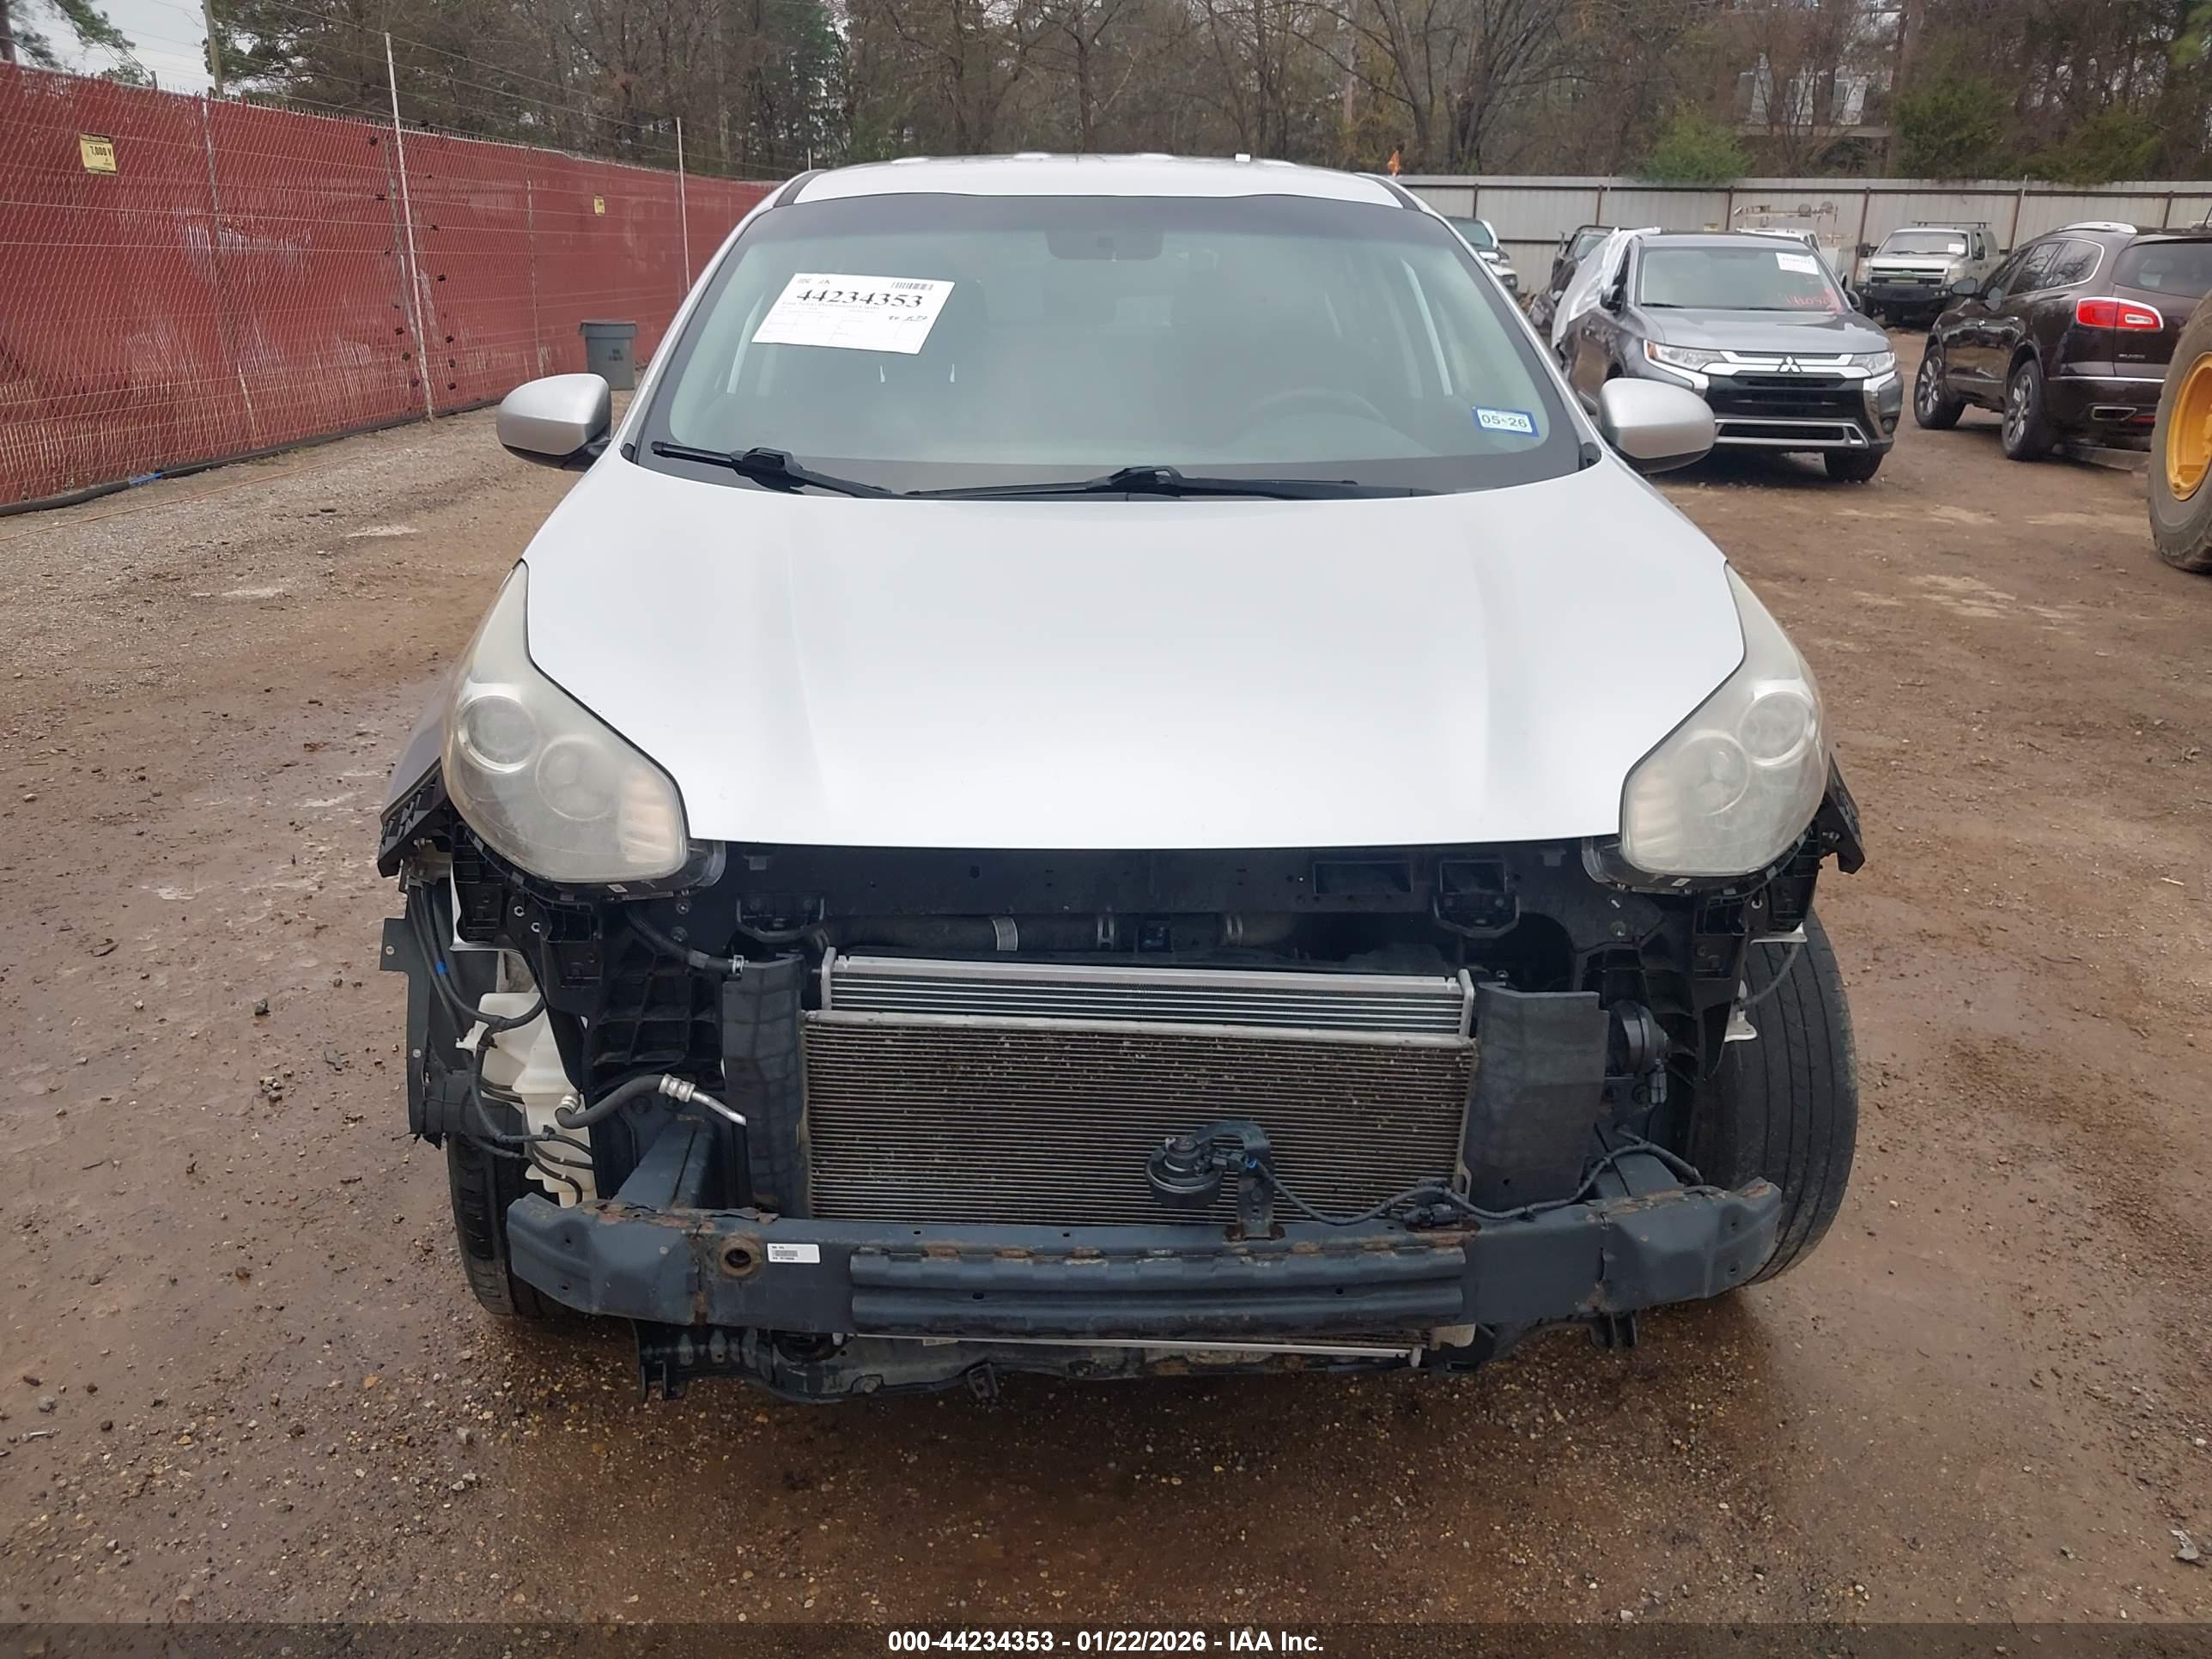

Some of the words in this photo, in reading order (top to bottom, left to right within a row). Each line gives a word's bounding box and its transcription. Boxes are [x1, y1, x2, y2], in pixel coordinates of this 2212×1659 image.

[89, 145, 107, 156] 7,000
[106, 147, 112, 157] V
[797, 289, 923, 307] 44234353
